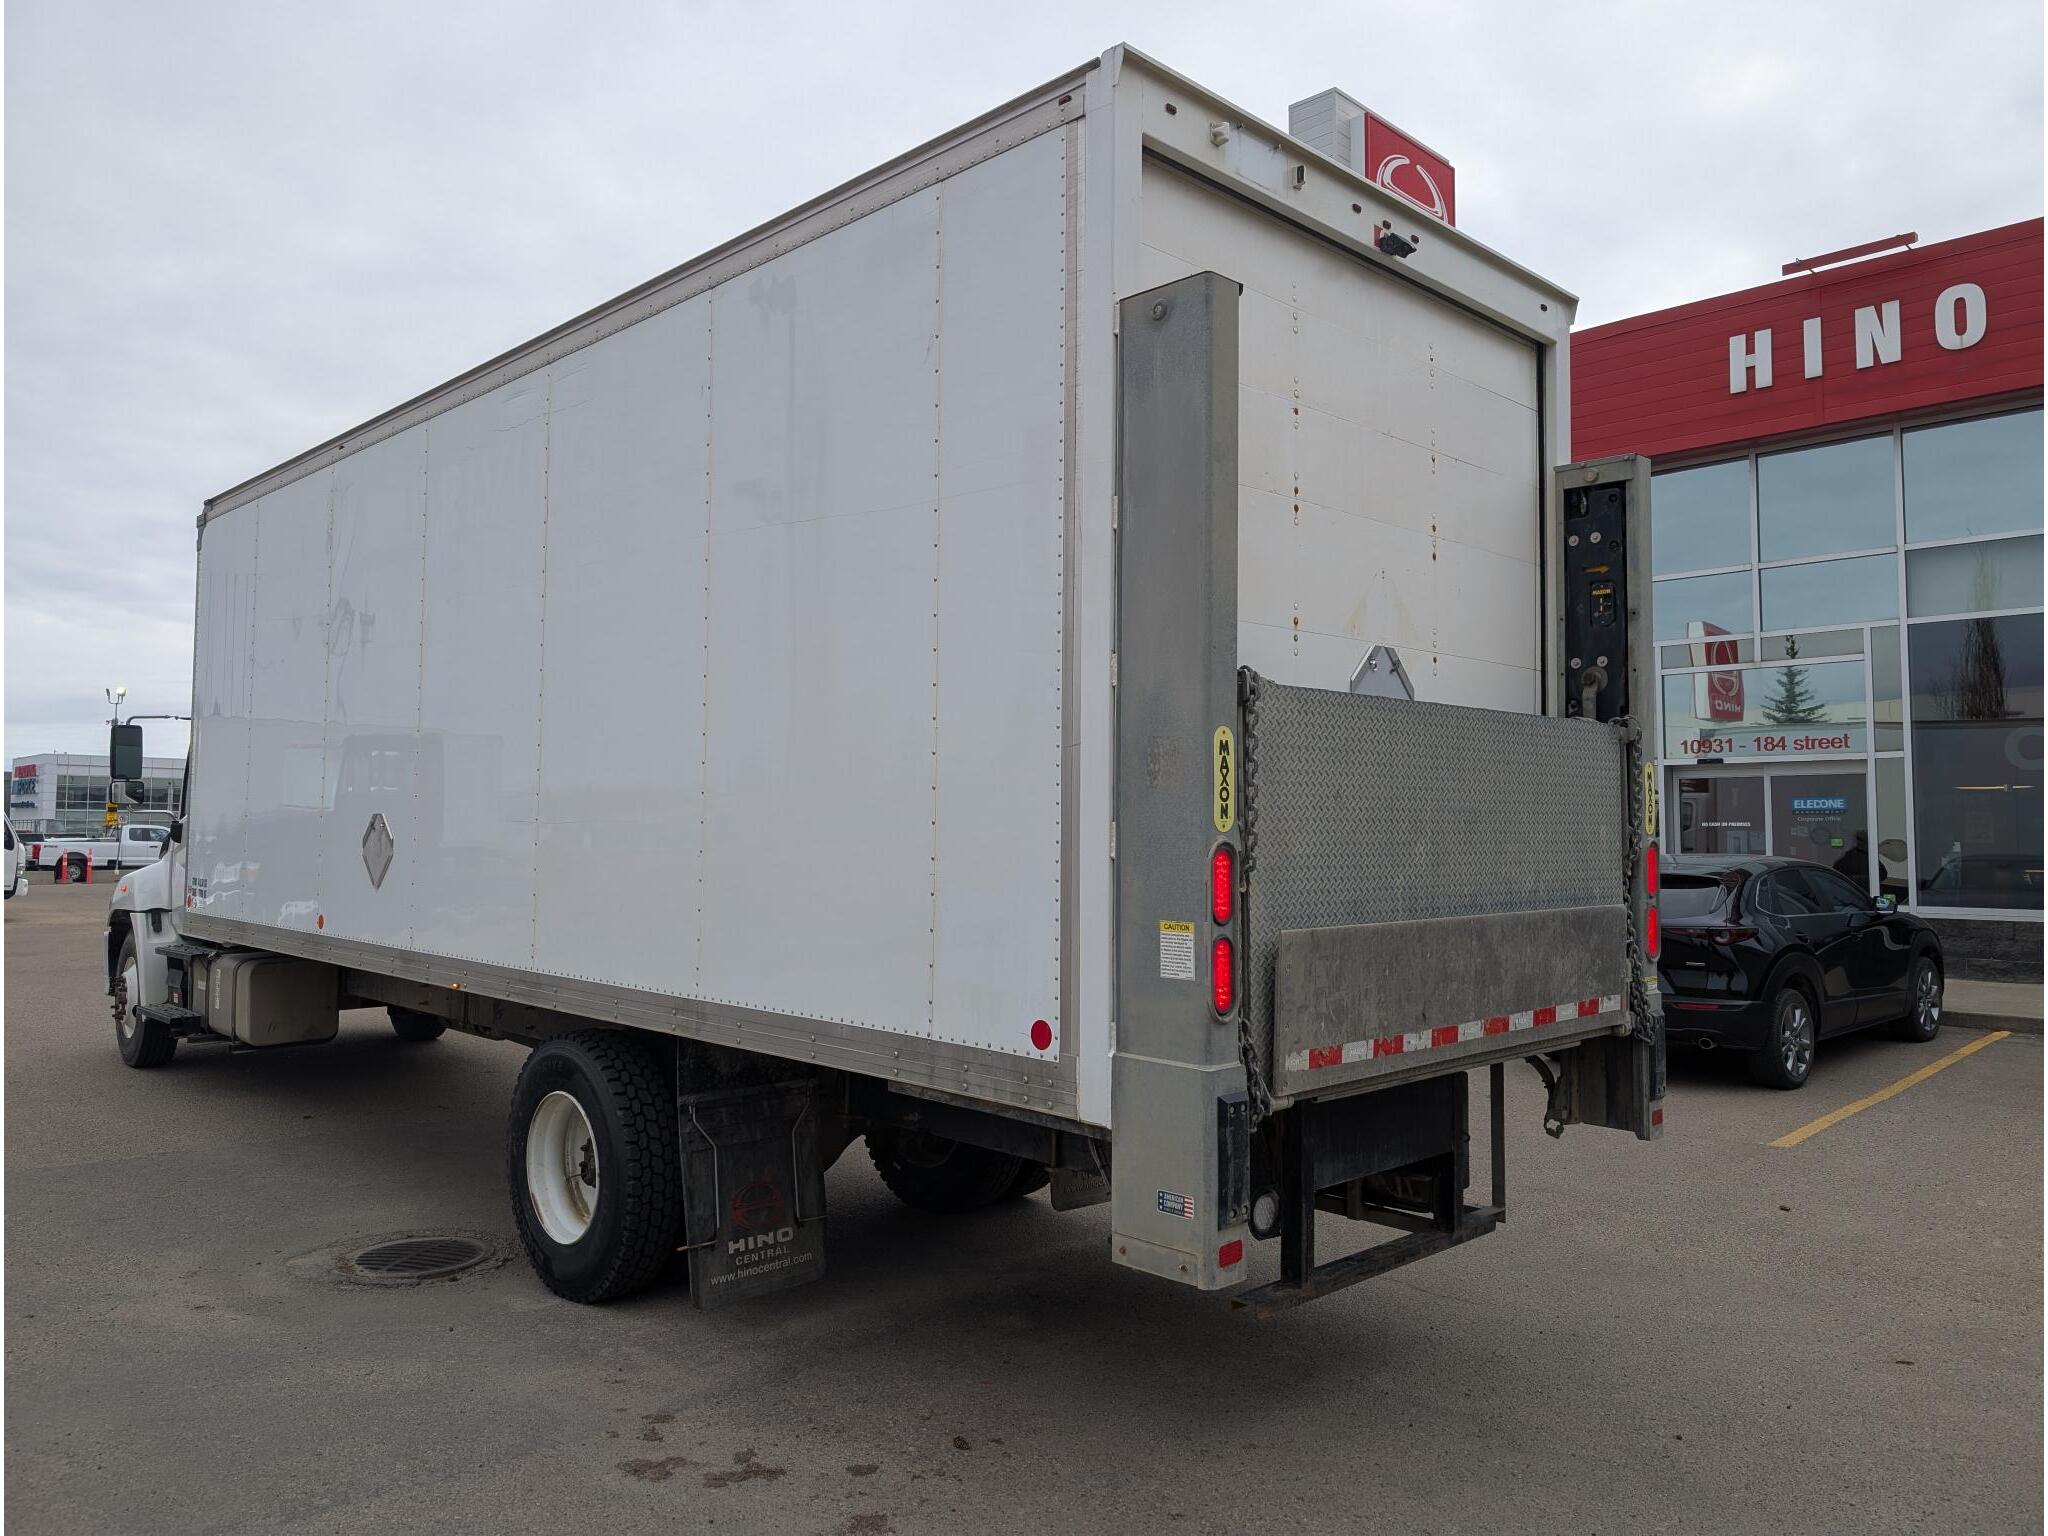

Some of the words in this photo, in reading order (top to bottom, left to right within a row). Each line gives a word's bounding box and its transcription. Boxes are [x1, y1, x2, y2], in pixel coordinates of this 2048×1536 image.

[1729, 282, 1987, 394] HINO
[1680, 737, 1734, 755] 10931
[1753, 735, 1787, 752] 184
[1793, 732, 1851, 751] street
[1218, 739, 1230, 820] MAXON
[1793, 799, 1845, 809] ELEDONE
[1163, 923, 1190, 931] CAUTION
[728, 1226, 794, 1255] HINO
[710, 1251, 813, 1287] www.hinocentral.com
[735, 1246, 790, 1266] CENTRAL
